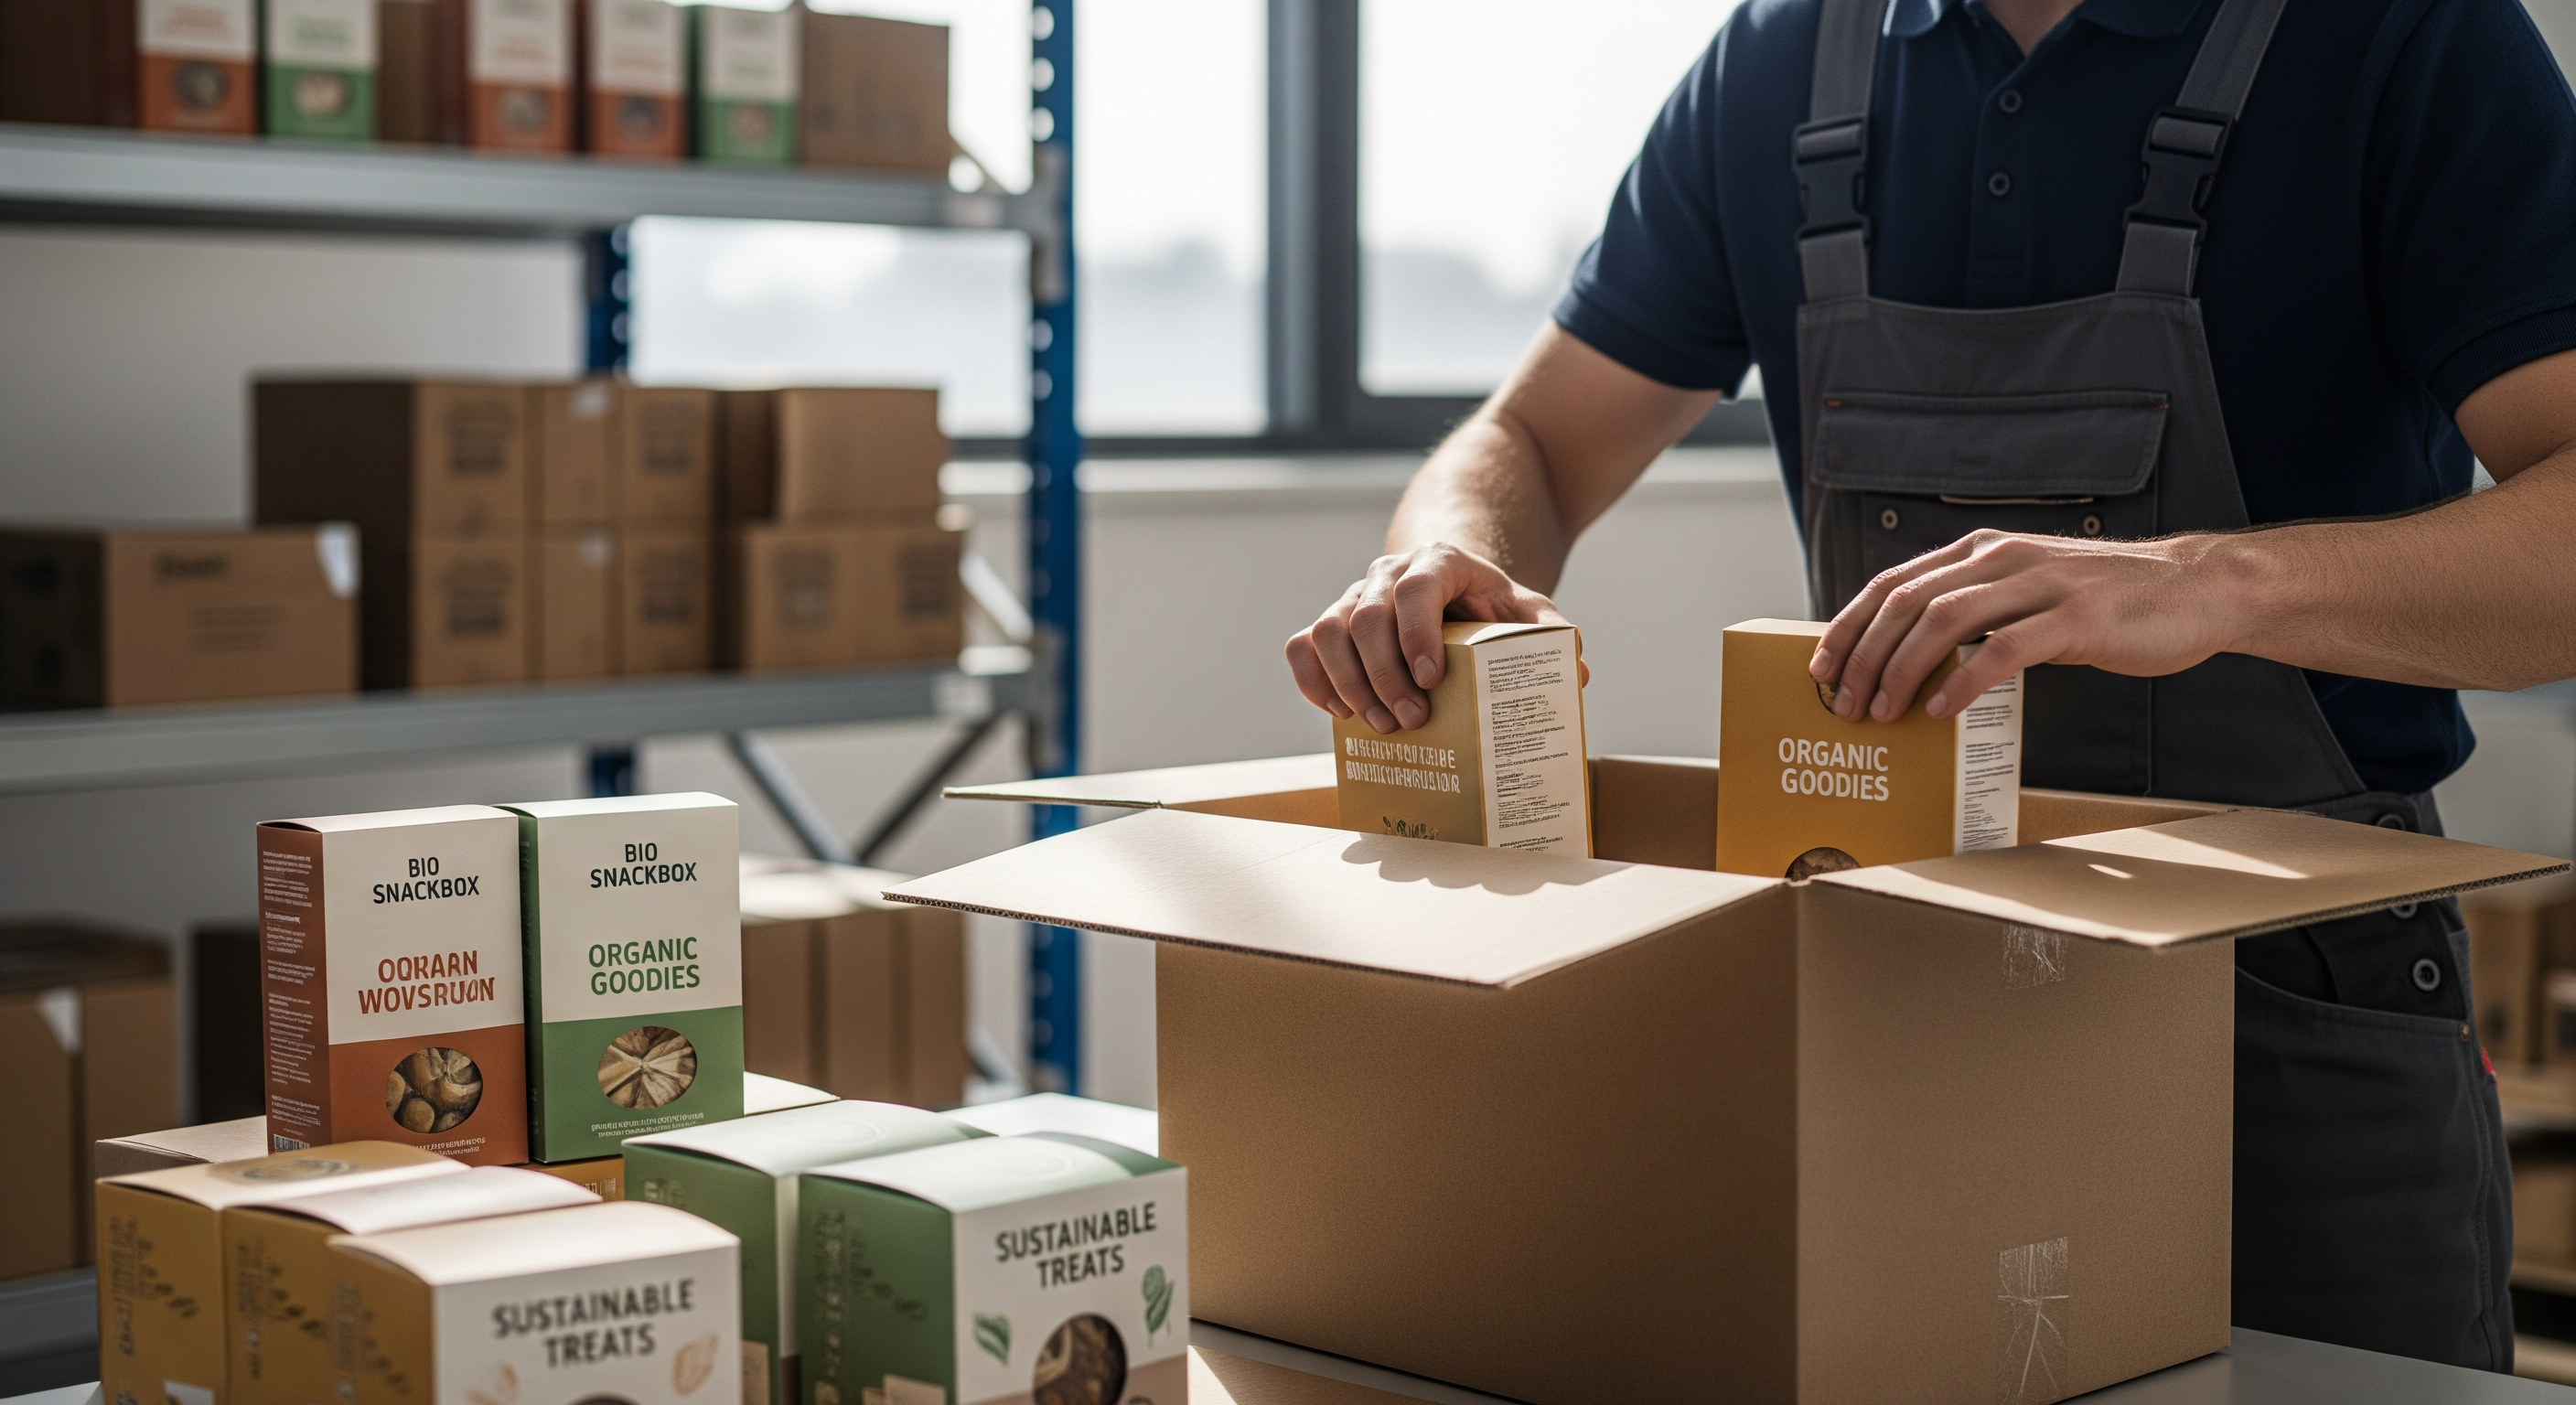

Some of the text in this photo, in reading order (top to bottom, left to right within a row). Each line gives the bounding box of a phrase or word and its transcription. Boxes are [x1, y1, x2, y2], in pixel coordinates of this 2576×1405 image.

[1778, 737, 1889, 772] ORGANIC
[1781, 767, 1890, 801] GOODIES
[408, 856, 439, 878] BIO
[625, 842, 658, 863] BIO
[372, 875, 480, 905] SNACKBOX
[590, 862, 697, 888] SNACKBOX
[588, 937, 698, 968] ORGANIC
[591, 963, 701, 995] GOODIES
[995, 1200, 1157, 1262] SUSTAINABLE
[1036, 1243, 1124, 1290] TREATS
[492, 1277, 695, 1339] SUSTAINABLE
[543, 1323, 656, 1370] TREATS
